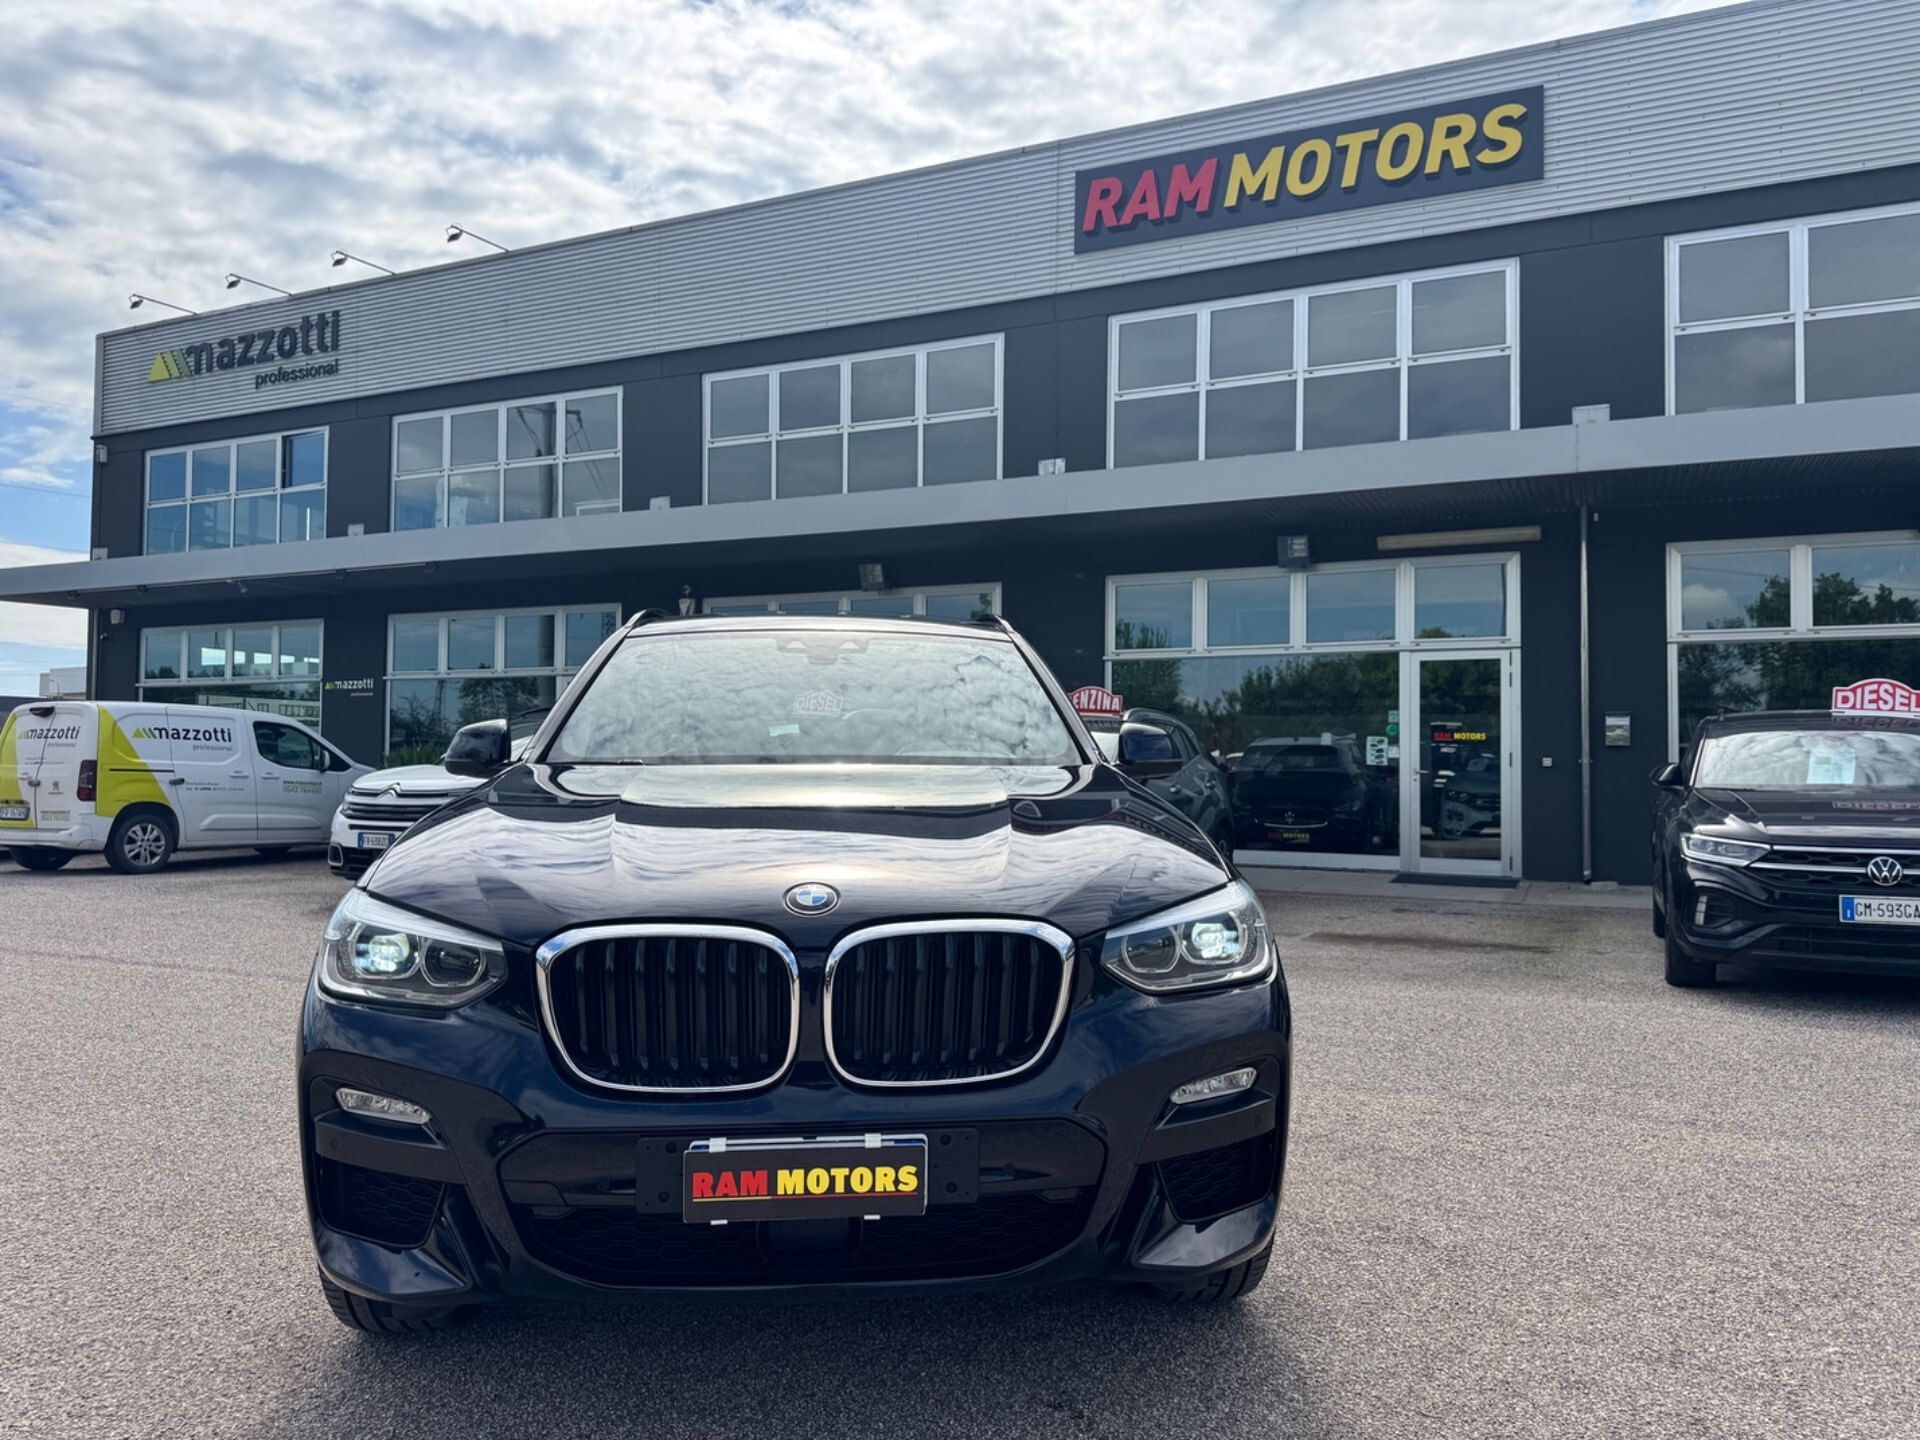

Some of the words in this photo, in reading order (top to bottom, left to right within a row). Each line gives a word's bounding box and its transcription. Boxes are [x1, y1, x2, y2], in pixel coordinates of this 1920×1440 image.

[1082, 157, 1221, 232] RAM
[1223, 103, 1528, 208] MOTORS
[184, 310, 341, 375] mazzotti
[255, 359, 339, 390] professional
[334, 677, 374, 689] mazzotti
[1836, 683, 1920, 712] DIESEL
[30, 725, 81, 740] mazzotti
[153, 726, 232, 743] mazzotti
[1454, 732, 1487, 741] MOTORS
[692, 1170, 769, 1198] RAM
[776, 1164, 919, 1196] MOTORS
